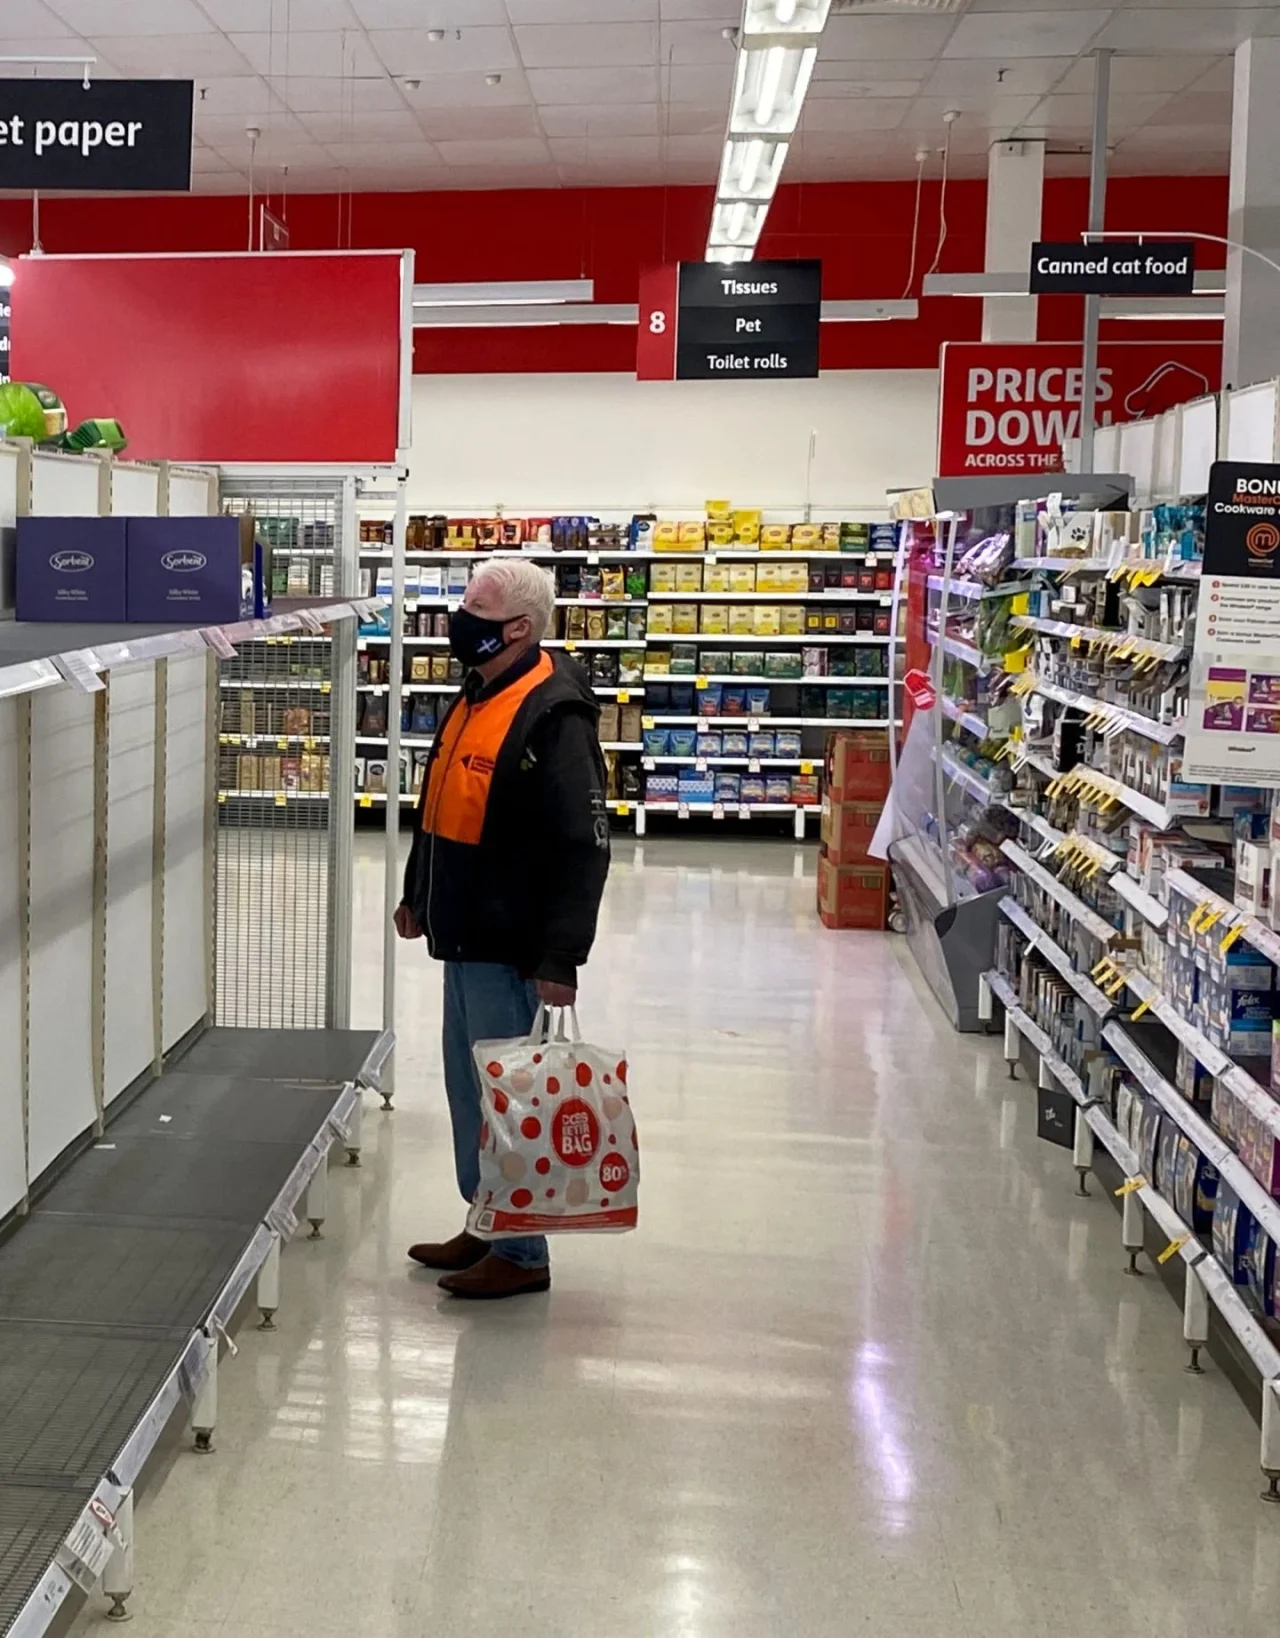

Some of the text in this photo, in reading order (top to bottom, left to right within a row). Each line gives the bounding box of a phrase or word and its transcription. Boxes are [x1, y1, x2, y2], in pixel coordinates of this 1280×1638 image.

[35, 119, 143, 156] paper
[1037, 257, 1188, 276] Canned cat food
[721, 280, 778, 295] Tissues
[649, 311, 666, 334] 8
[735, 318, 762, 333] Pet
[706, 353, 788, 370] Toilet rolls
[967, 367, 1114, 403] PRICES
[965, 409, 1112, 447] DOW
[964, 453, 1059, 468] ACROSS THE
[1236, 478, 1280, 495] BON
[1214, 502, 1276, 516] Cookware
[561, 1134, 593, 1155] BAG
